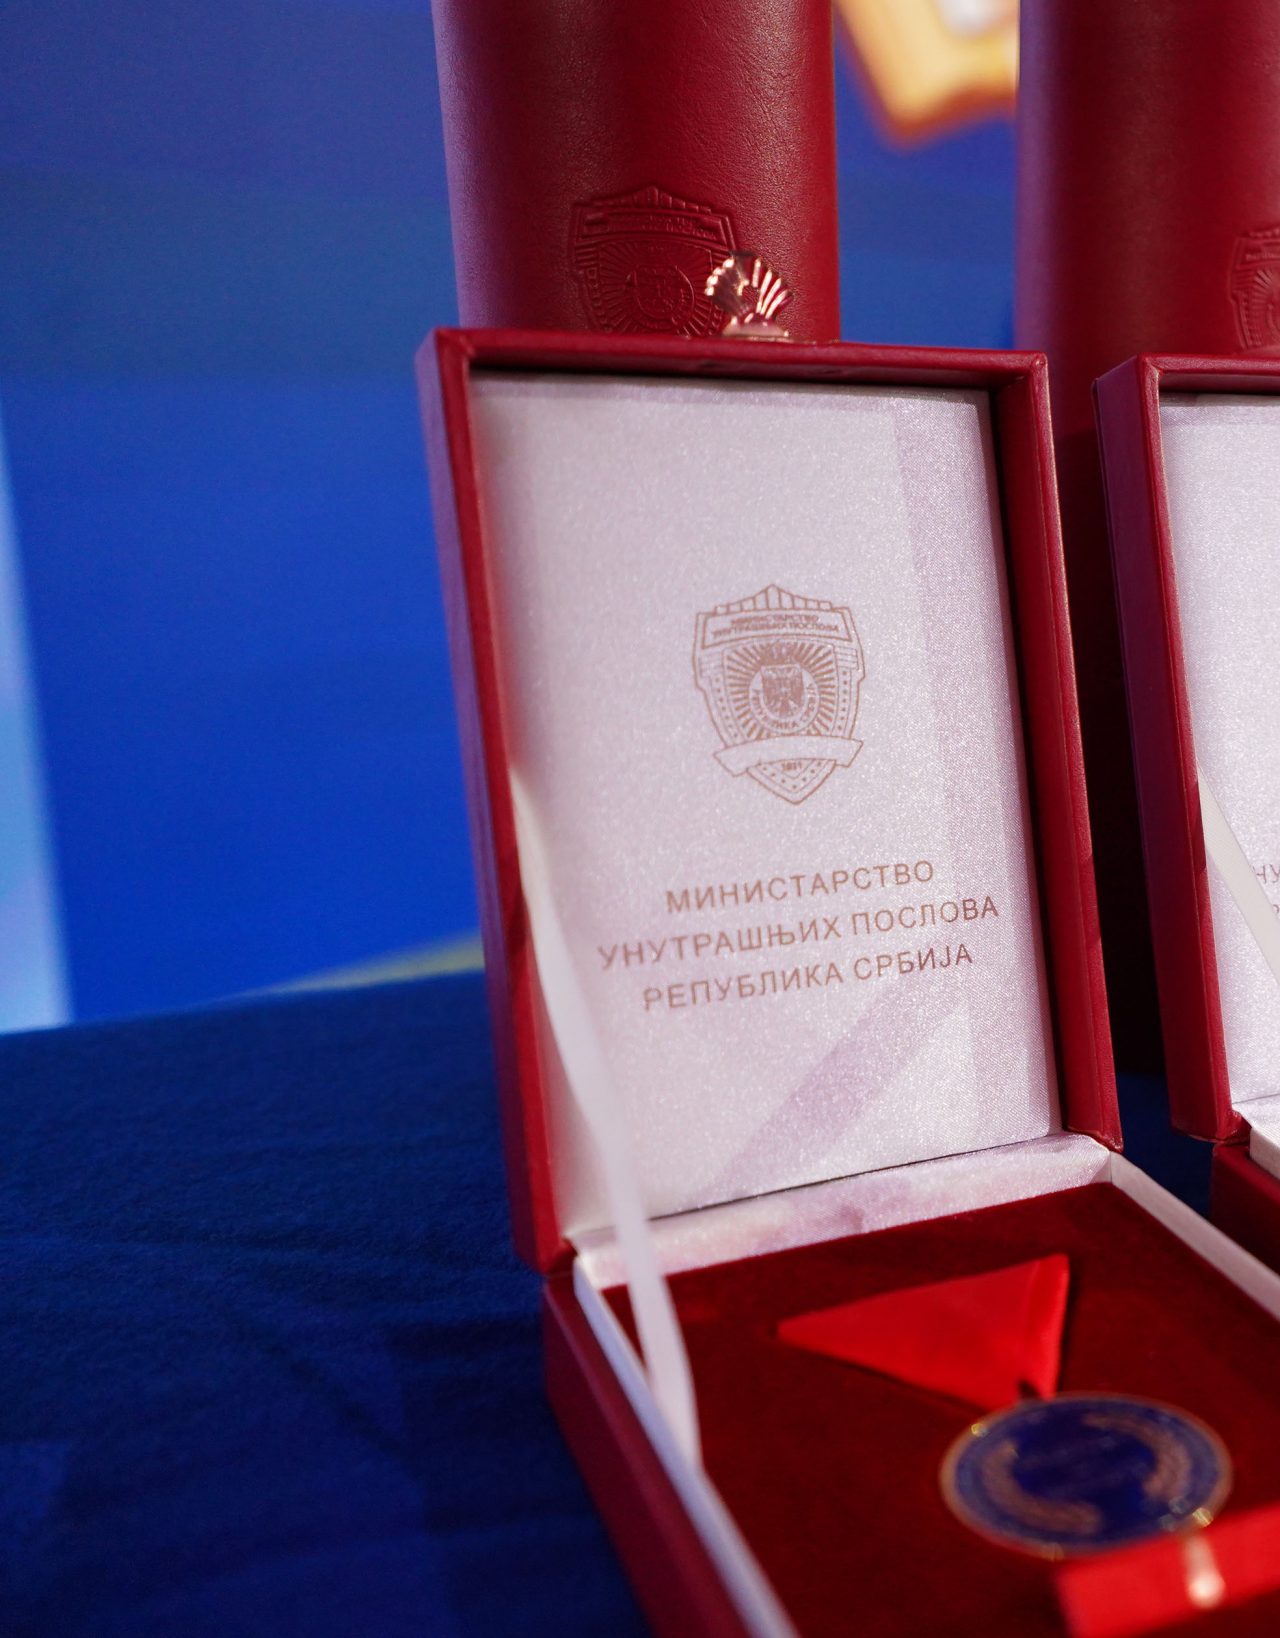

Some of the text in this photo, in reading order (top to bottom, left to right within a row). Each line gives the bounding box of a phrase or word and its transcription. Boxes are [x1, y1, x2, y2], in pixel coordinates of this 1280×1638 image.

[665, 860, 934, 914] МИНИСТАРСТВО
[597, 895, 999, 971] УНУТРАШЊИХ ПОСЛОВА
[642, 943, 974, 1012] РЕПУБЛИКА СРБИЈА
